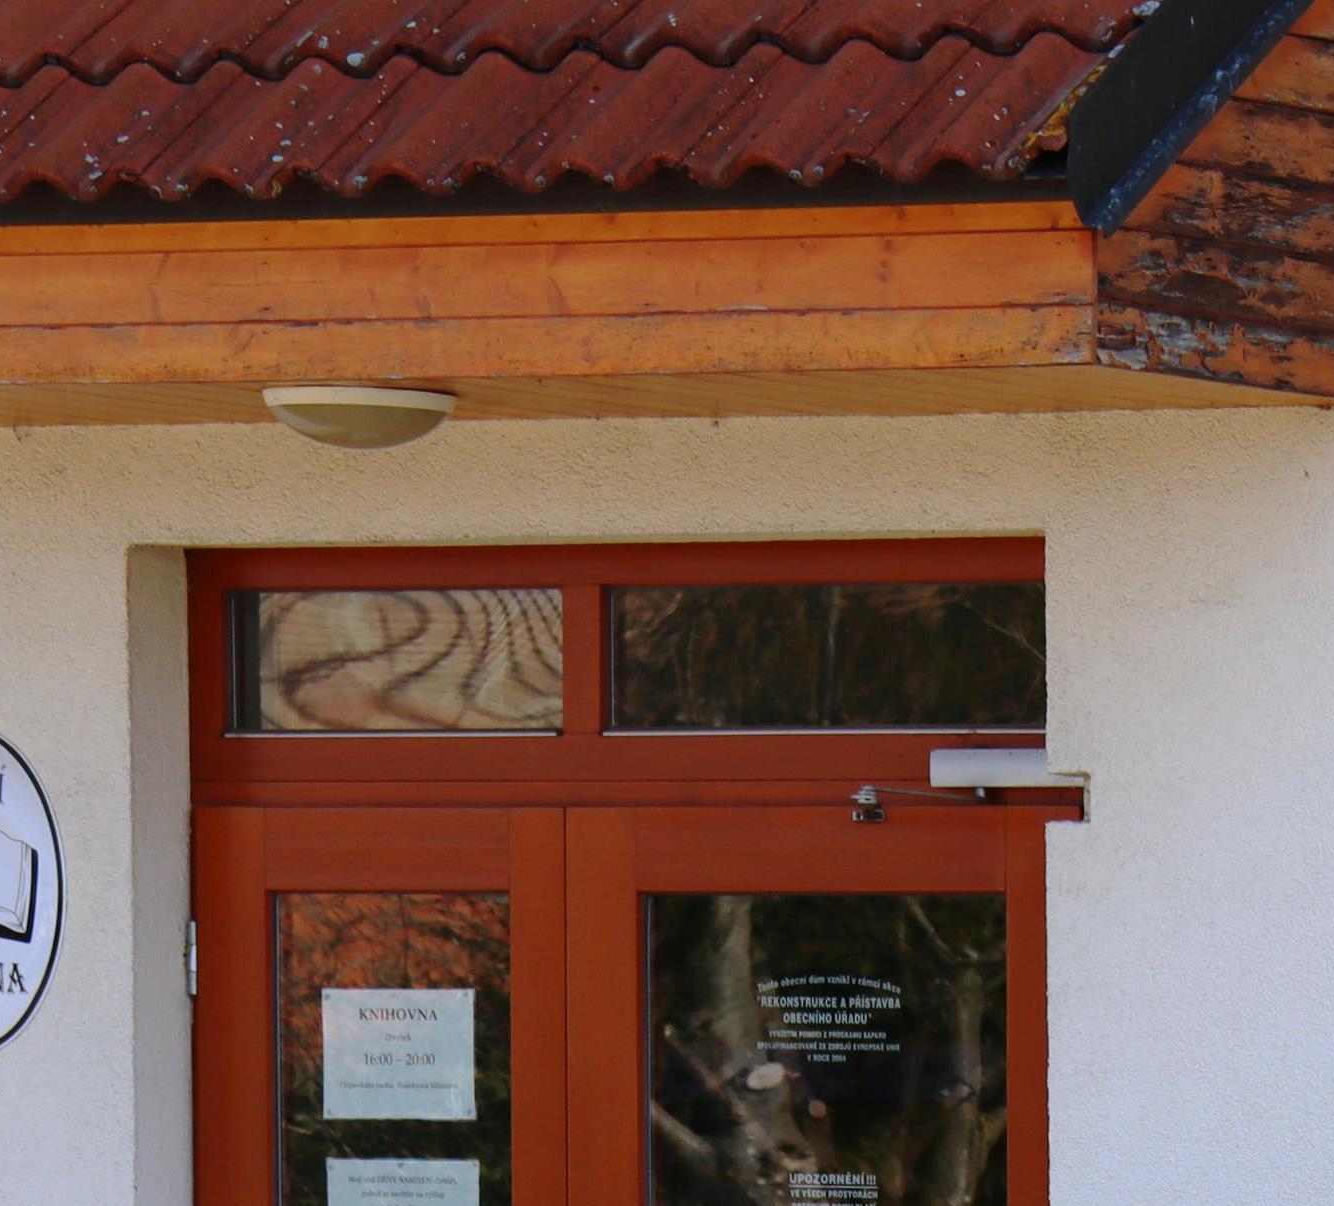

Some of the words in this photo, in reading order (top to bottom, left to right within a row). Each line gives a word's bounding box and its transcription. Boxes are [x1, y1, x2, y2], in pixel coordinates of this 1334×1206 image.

[757, 980, 778, 993] Tento
[781, 976, 807, 986] obecní
[808, 975, 826, 984] dům
[827, 975, 850, 983] vznikl
[858, 976, 880, 989] rámci
[882, 981, 901, 994] akce
[840, 997, 847, 1008] A
[849, 994, 901, 1009] PŘÍSTAVBA
[358, 1007, 438, 1021] KNIHOVNA
[783, 1010, 832, 1024] OBECNÍHO
[364, 1053, 393, 1066] 16:00
[405, 1053, 435, 1066] 20:00
[789, 1172, 864, 1185] UPOZORNĚNÍ
[790, 1189, 800, 1198] VE
[801, 1188, 827, 1198] VŠECH
